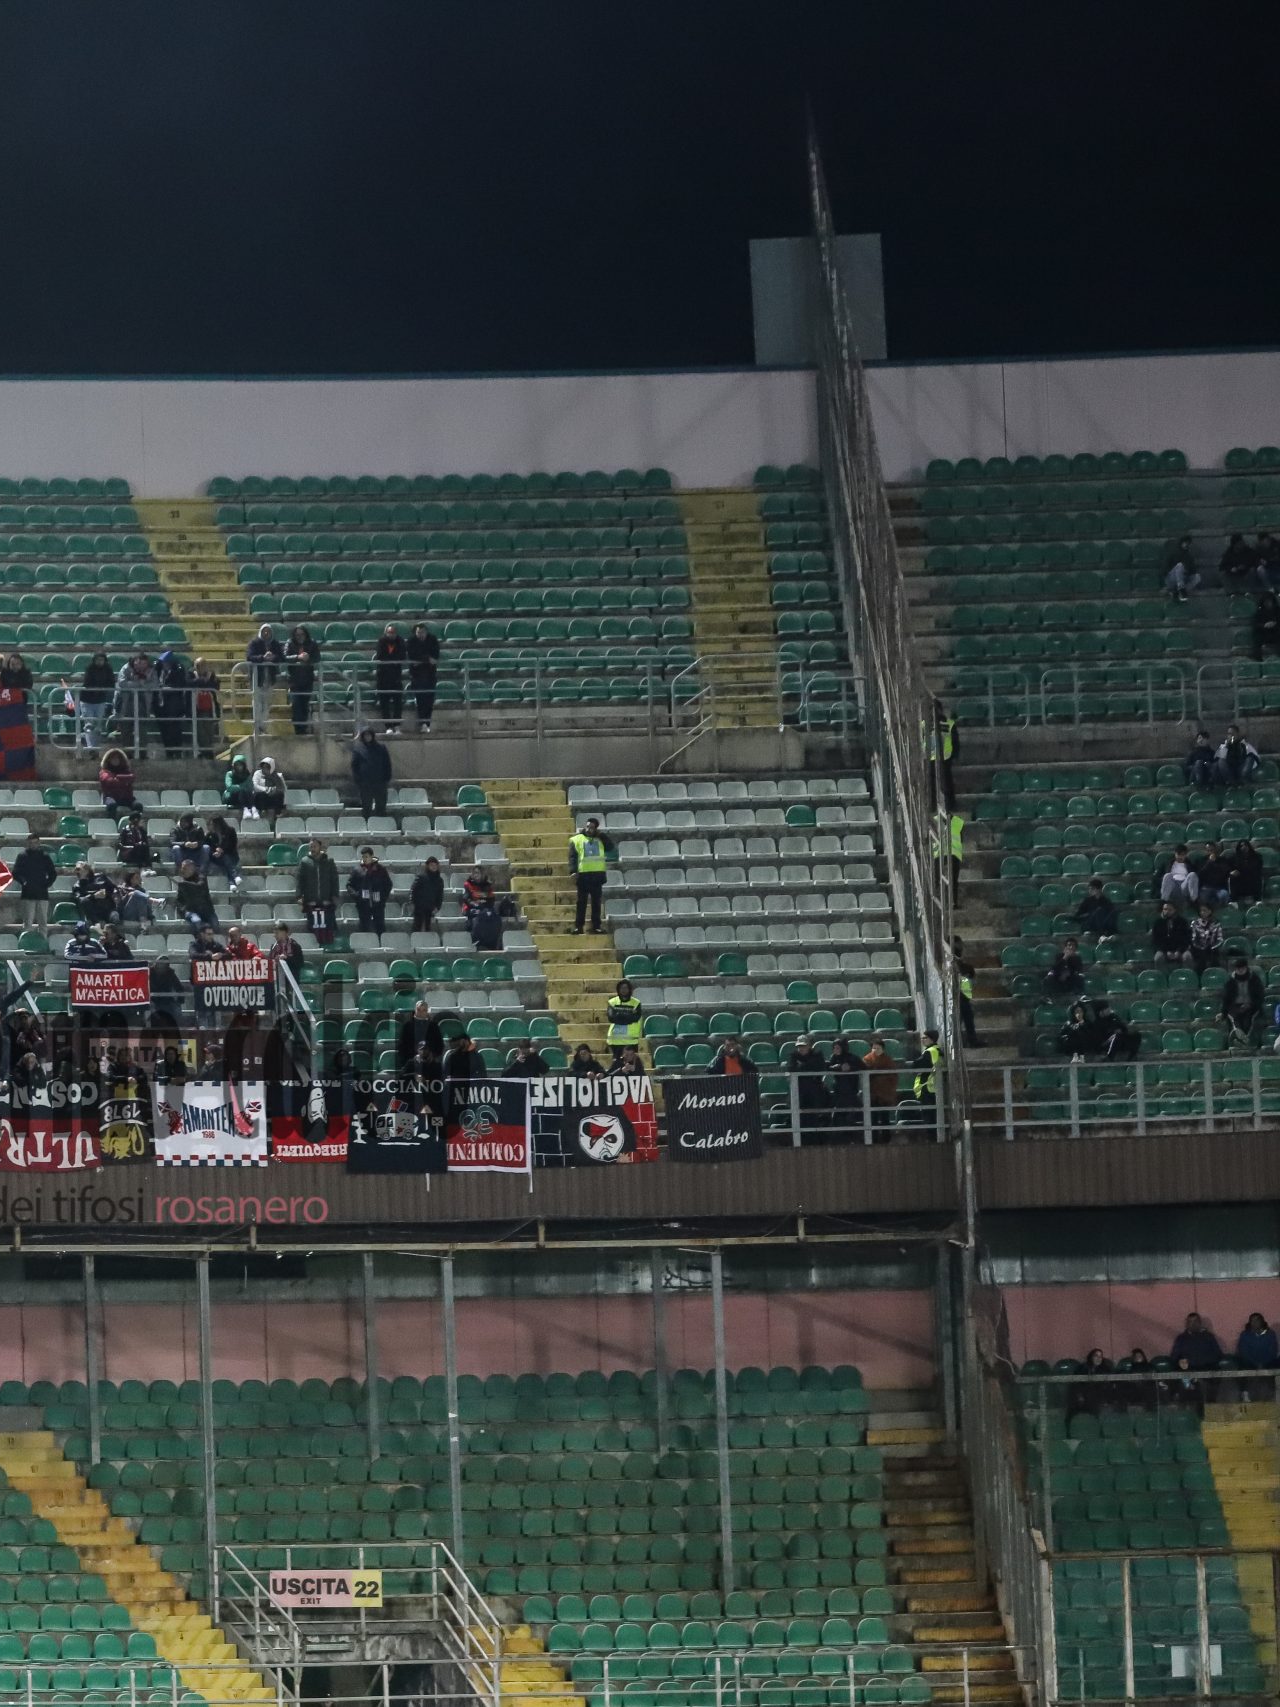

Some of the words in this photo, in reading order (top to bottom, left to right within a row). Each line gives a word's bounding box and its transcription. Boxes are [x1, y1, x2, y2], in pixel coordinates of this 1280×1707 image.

[312, 910, 326, 929] 11
[76, 974, 124, 987] AMARTI
[196, 960, 269, 982] EMANUELE
[76, 988, 145, 1002] M'AFFATICA
[204, 986, 265, 1009] OVUNQUE
[454, 1086, 501, 1105] TOWN
[678, 1092, 746, 1110] Morano
[104, 1104, 141, 1121] 1978
[182, 1102, 235, 1137] AMANTEA
[680, 1129, 749, 1148] Calabro
[272, 1578, 350, 1595] USCITA
[355, 1581, 380, 1598] 22
